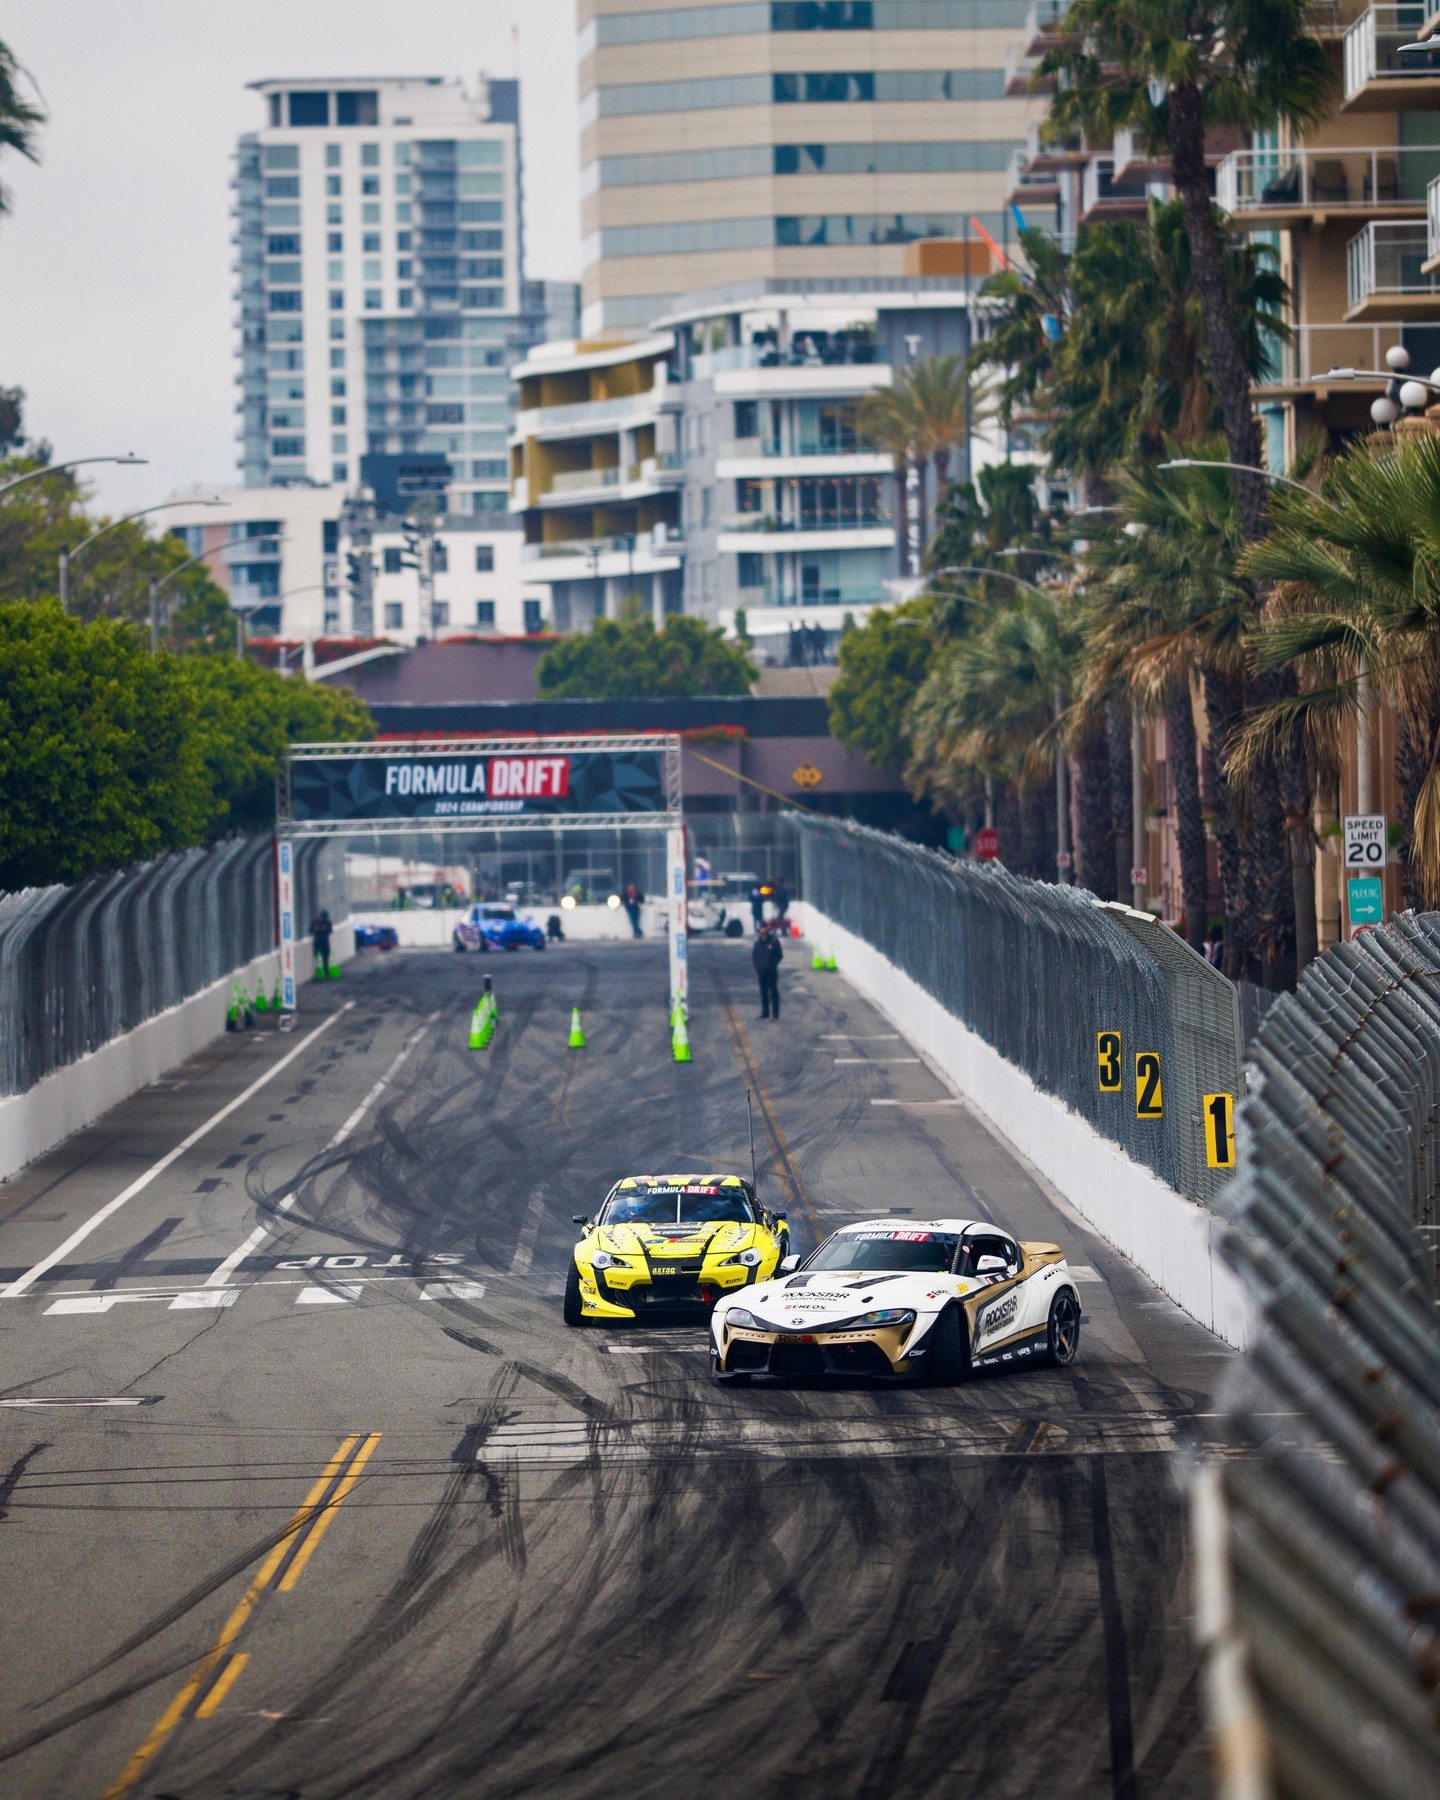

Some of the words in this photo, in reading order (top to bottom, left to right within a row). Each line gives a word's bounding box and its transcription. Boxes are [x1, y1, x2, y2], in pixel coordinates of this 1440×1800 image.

[385, 764, 486, 795] FORMULA
[491, 759, 566, 796] DRIFT
[435, 801, 458, 814] 2024
[460, 799, 524, 814] CHAMPIONSHIP
[1347, 820, 1383, 830] SPEED
[1351, 831, 1379, 840] LIMIT
[975, 838, 998, 850] STO
[1348, 843, 1382, 862] 20
[1351, 887, 1379, 899] PARKING
[1099, 1033, 1121, 1087] 3
[1137, 1054, 1163, 1114] 2
[1209, 1096, 1229, 1163] 1
[647, 1186, 686, 1195] FORMULA
[687, 1185, 717, 1195] DRIFT
[854, 1231, 894, 1241] FORMULA
[894, 1231, 928, 1241] DRIFT
[275, 1253, 465, 1270] STOP
[781, 1291, 850, 1299] ROCKSTAR
[984, 1295, 1018, 1330] ROCKSTAR
